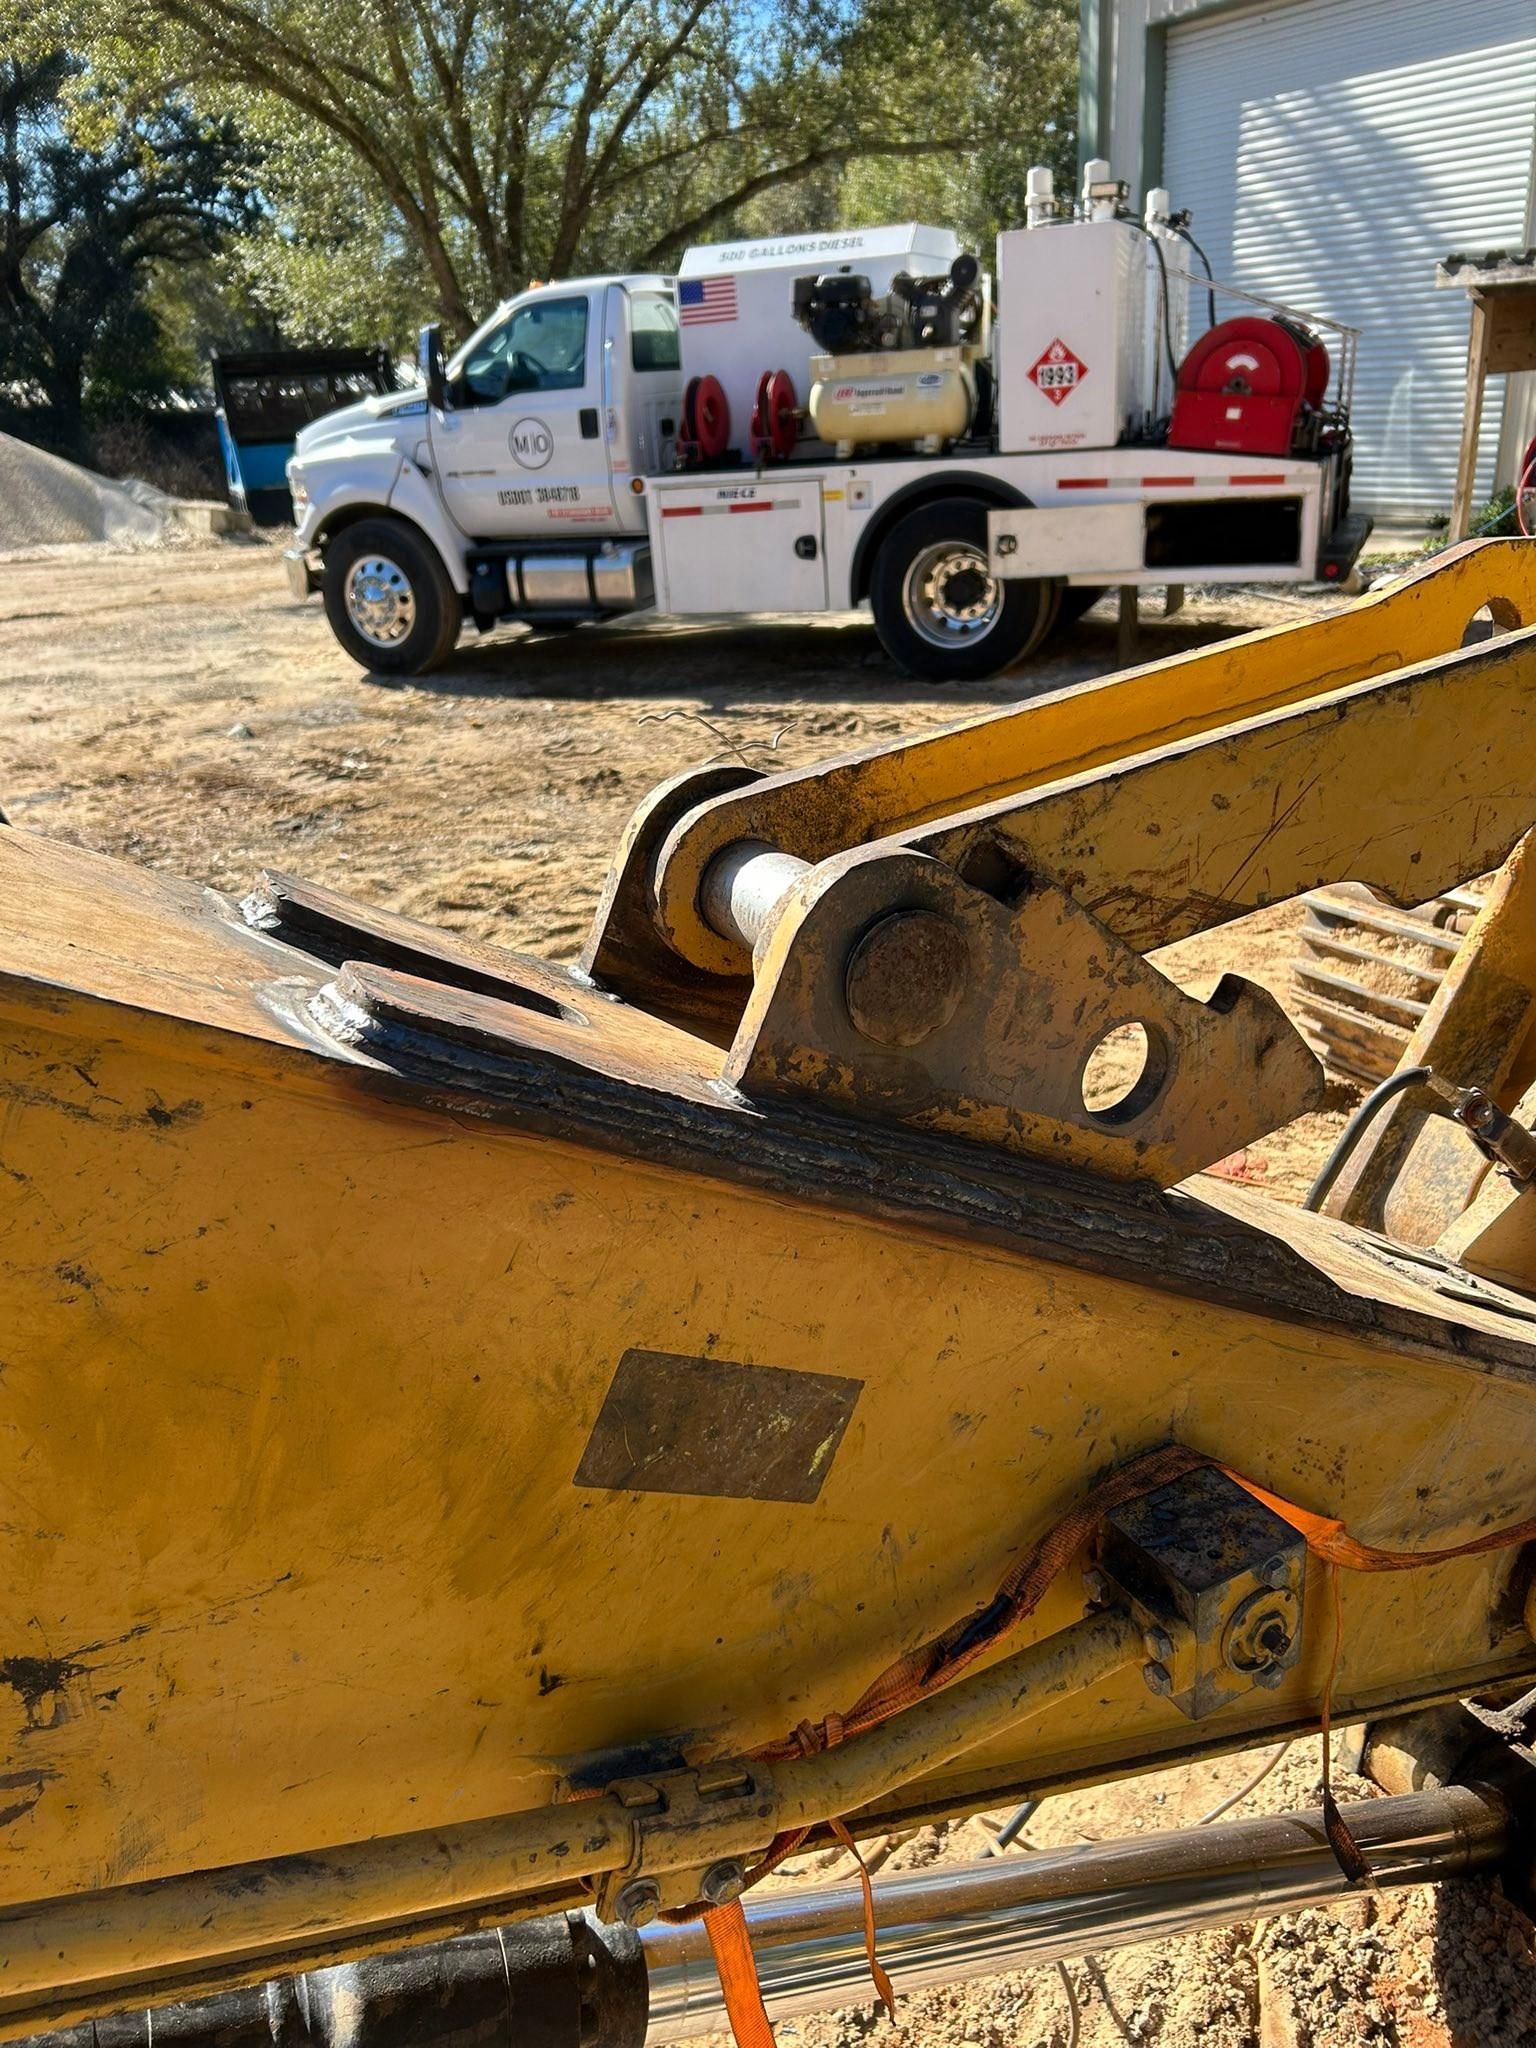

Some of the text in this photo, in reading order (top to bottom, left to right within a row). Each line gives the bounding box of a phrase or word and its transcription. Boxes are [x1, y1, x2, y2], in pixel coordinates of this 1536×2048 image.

[750, 243, 817, 259] GALLONS
[819, 236, 864, 251] DIESEL
[1039, 364, 1075, 387] 1993
